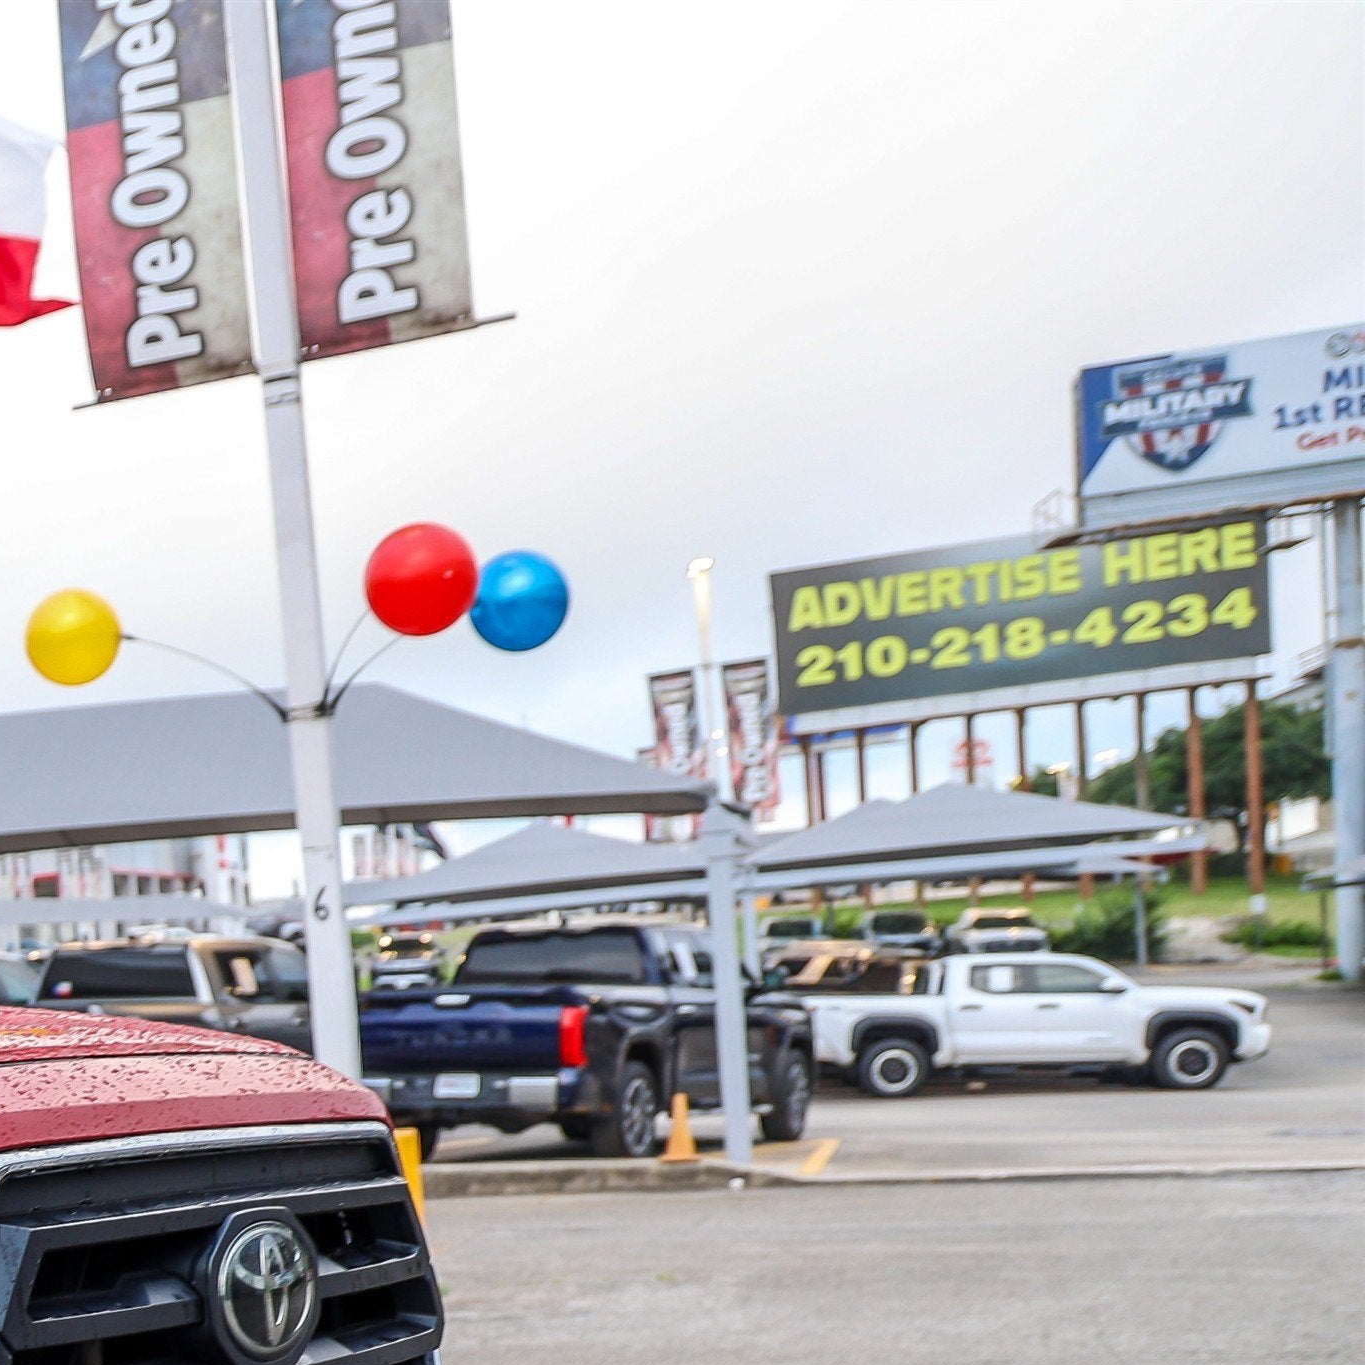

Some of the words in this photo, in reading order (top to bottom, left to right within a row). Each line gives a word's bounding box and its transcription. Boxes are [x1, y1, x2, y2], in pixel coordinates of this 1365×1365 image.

[325, 0, 408, 181] Own
[125, 236, 205, 369] Pre
[338, 187, 420, 325] Pre
[1103, 381, 1247, 424] MILITARY
[788, 548, 1082, 633] ADVERTISE
[1102, 521, 1258, 588] HERE
[795, 586, 1258, 688] 210-218-4234
[313, 885, 329, 922] 6
